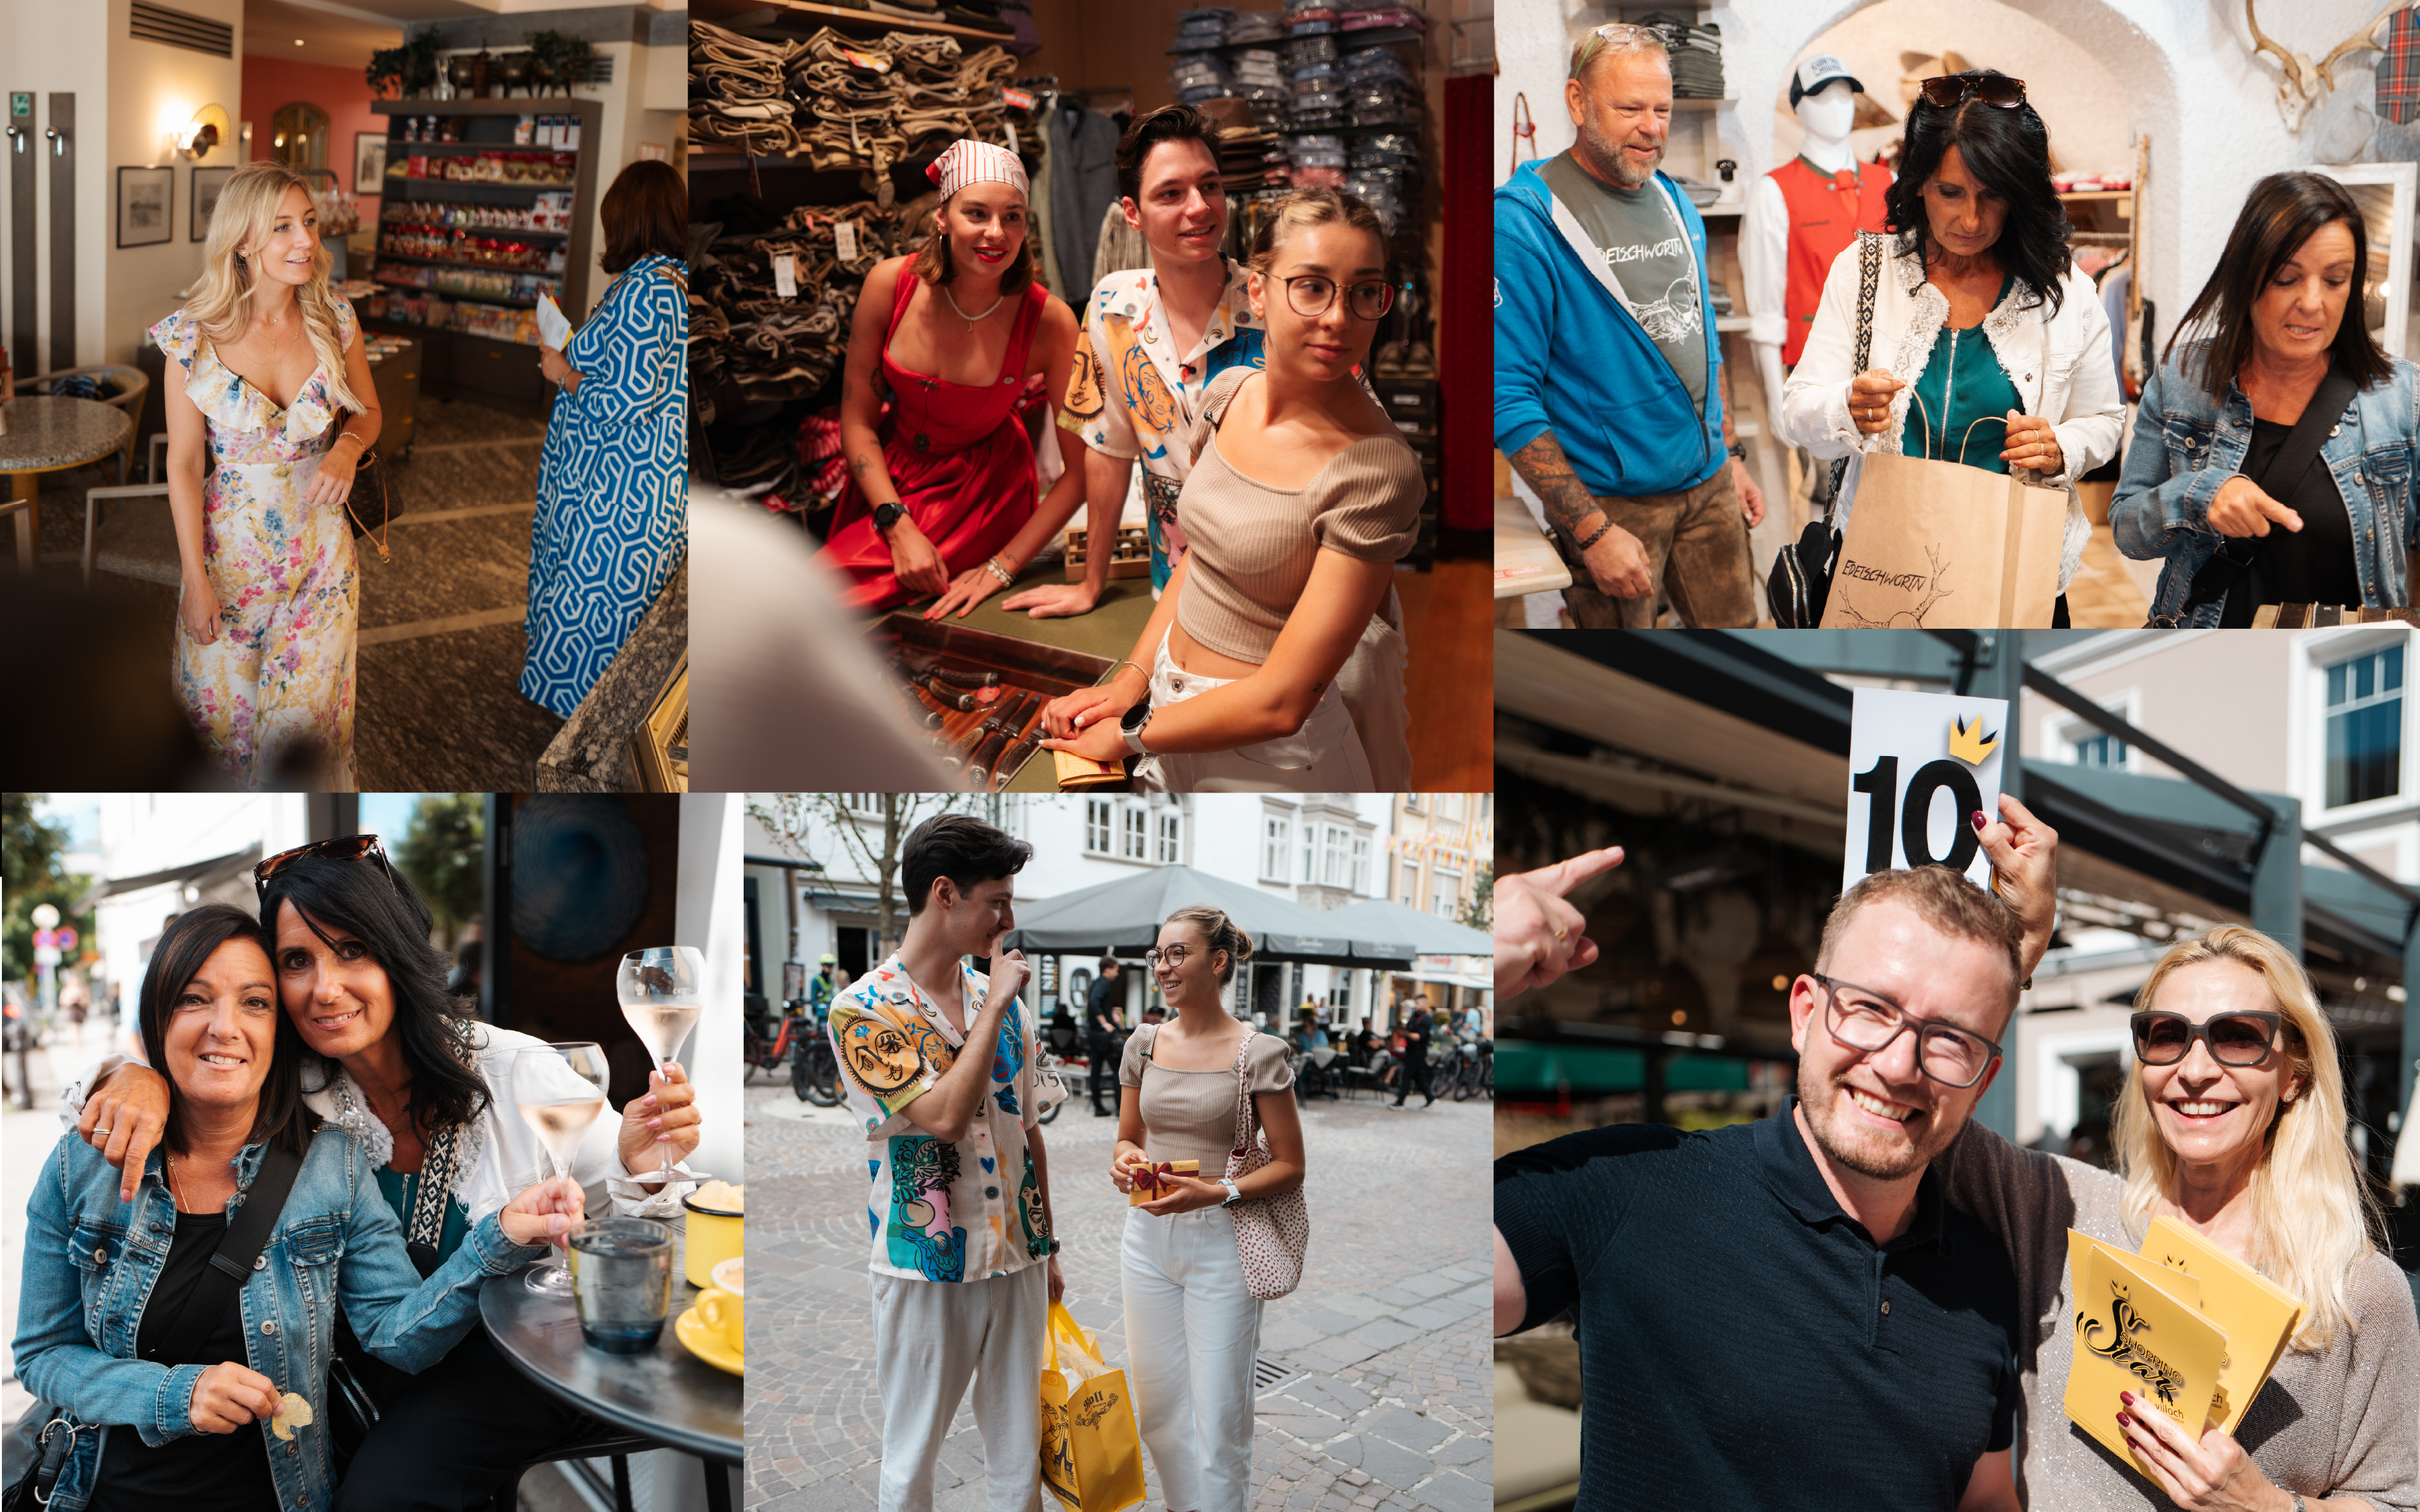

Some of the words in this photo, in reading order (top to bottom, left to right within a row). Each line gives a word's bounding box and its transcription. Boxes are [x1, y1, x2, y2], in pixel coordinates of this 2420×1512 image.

[1853, 755, 1983, 874] 10
[2083, 1298, 2177, 1391] Star
[2121, 1332, 2182, 1383] SHOPPING
[2155, 1402, 2184, 1419] villach
